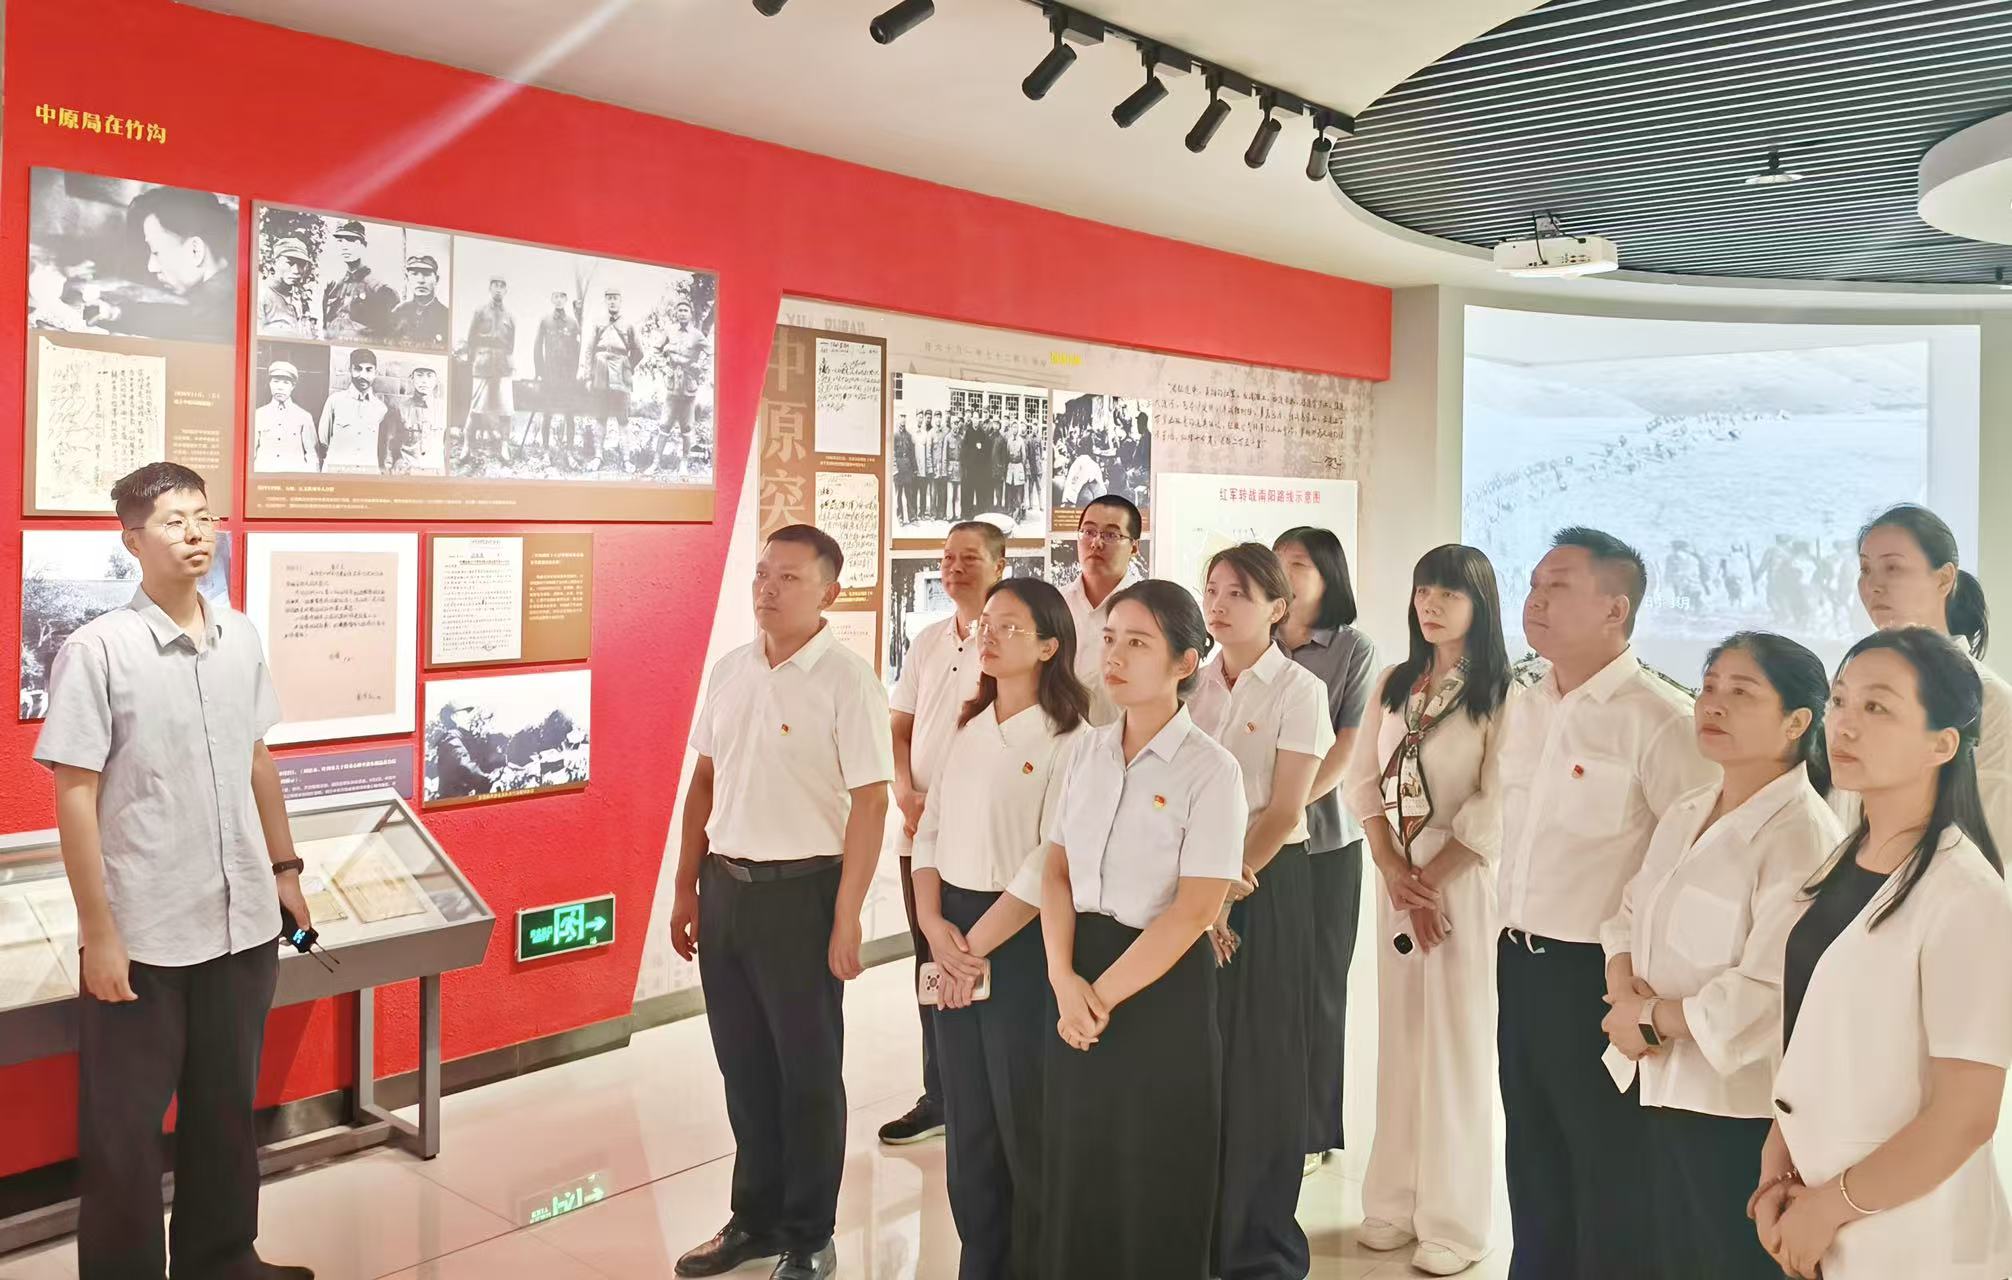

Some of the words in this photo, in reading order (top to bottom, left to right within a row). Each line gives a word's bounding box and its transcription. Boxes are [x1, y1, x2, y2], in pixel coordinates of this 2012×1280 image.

[35, 103, 167, 144] 中原局在竹沟
[1219, 487, 1321, 504] 红军转战南阳路线示意图
